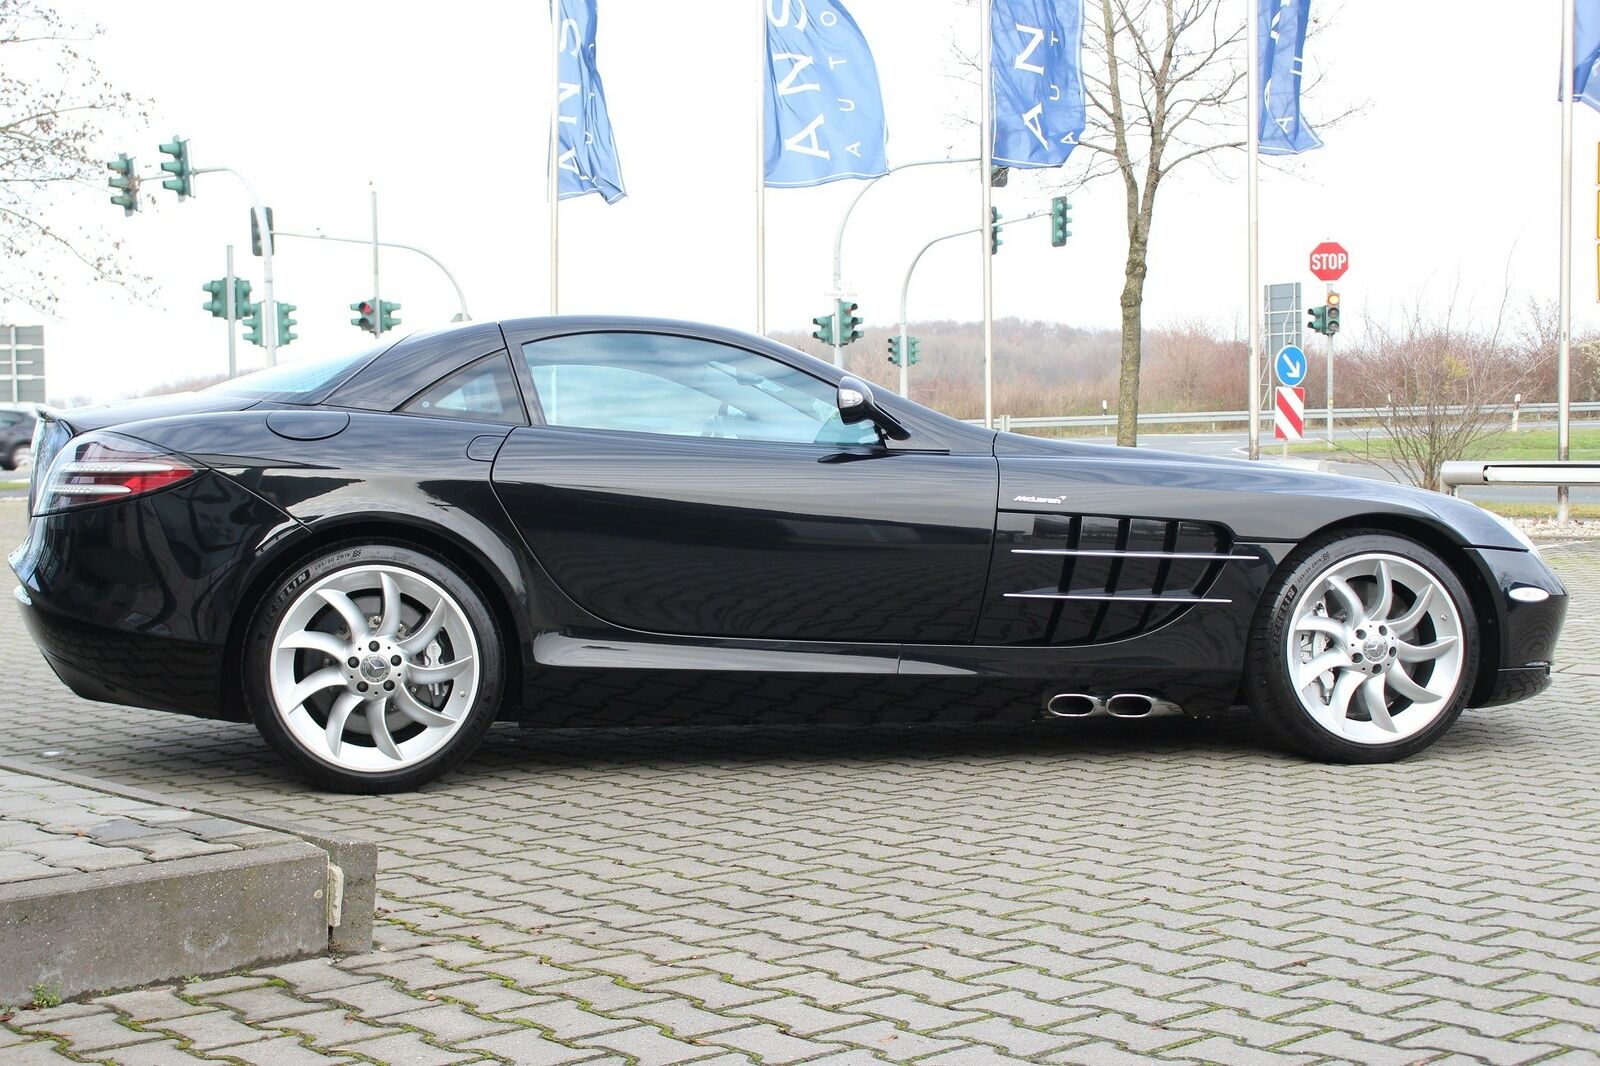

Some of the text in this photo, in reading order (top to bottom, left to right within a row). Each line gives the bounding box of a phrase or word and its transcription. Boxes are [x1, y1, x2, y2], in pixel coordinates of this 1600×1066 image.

[819, 10, 862, 158] AUTO
[1311, 252, 1347, 270] STOP
[261, 571, 308, 631] ICHELIN
